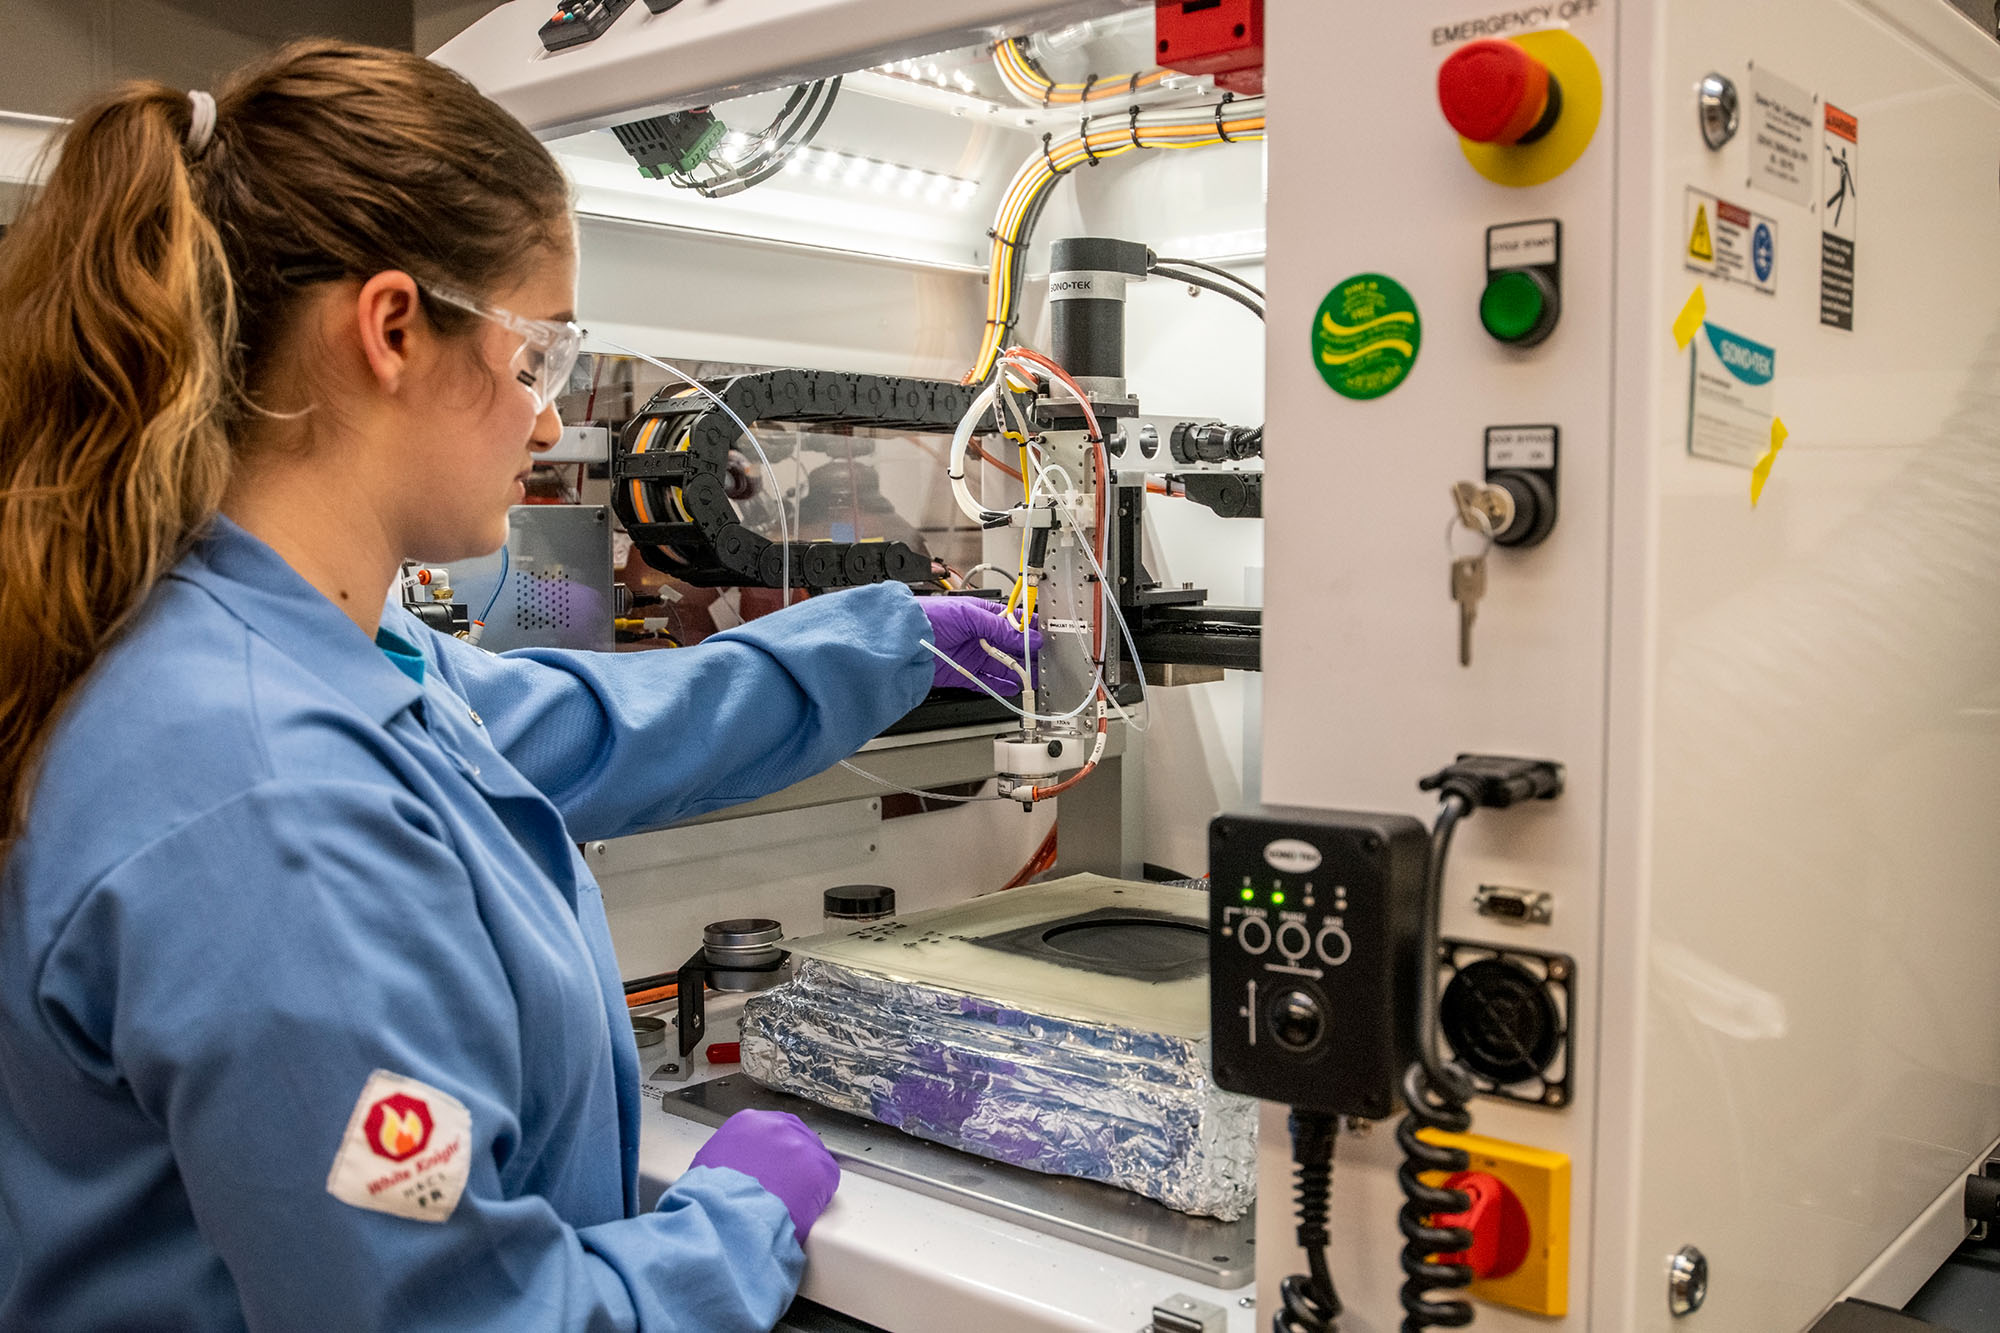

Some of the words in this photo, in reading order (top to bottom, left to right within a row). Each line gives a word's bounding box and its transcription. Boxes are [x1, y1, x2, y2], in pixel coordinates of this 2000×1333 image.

[1432, 4, 1552, 46] EMERGENCY
[1559, 0, 1599, 20] OFF
[368, 1169, 410, 1196] White
[415, 1133, 460, 1173] Knight
